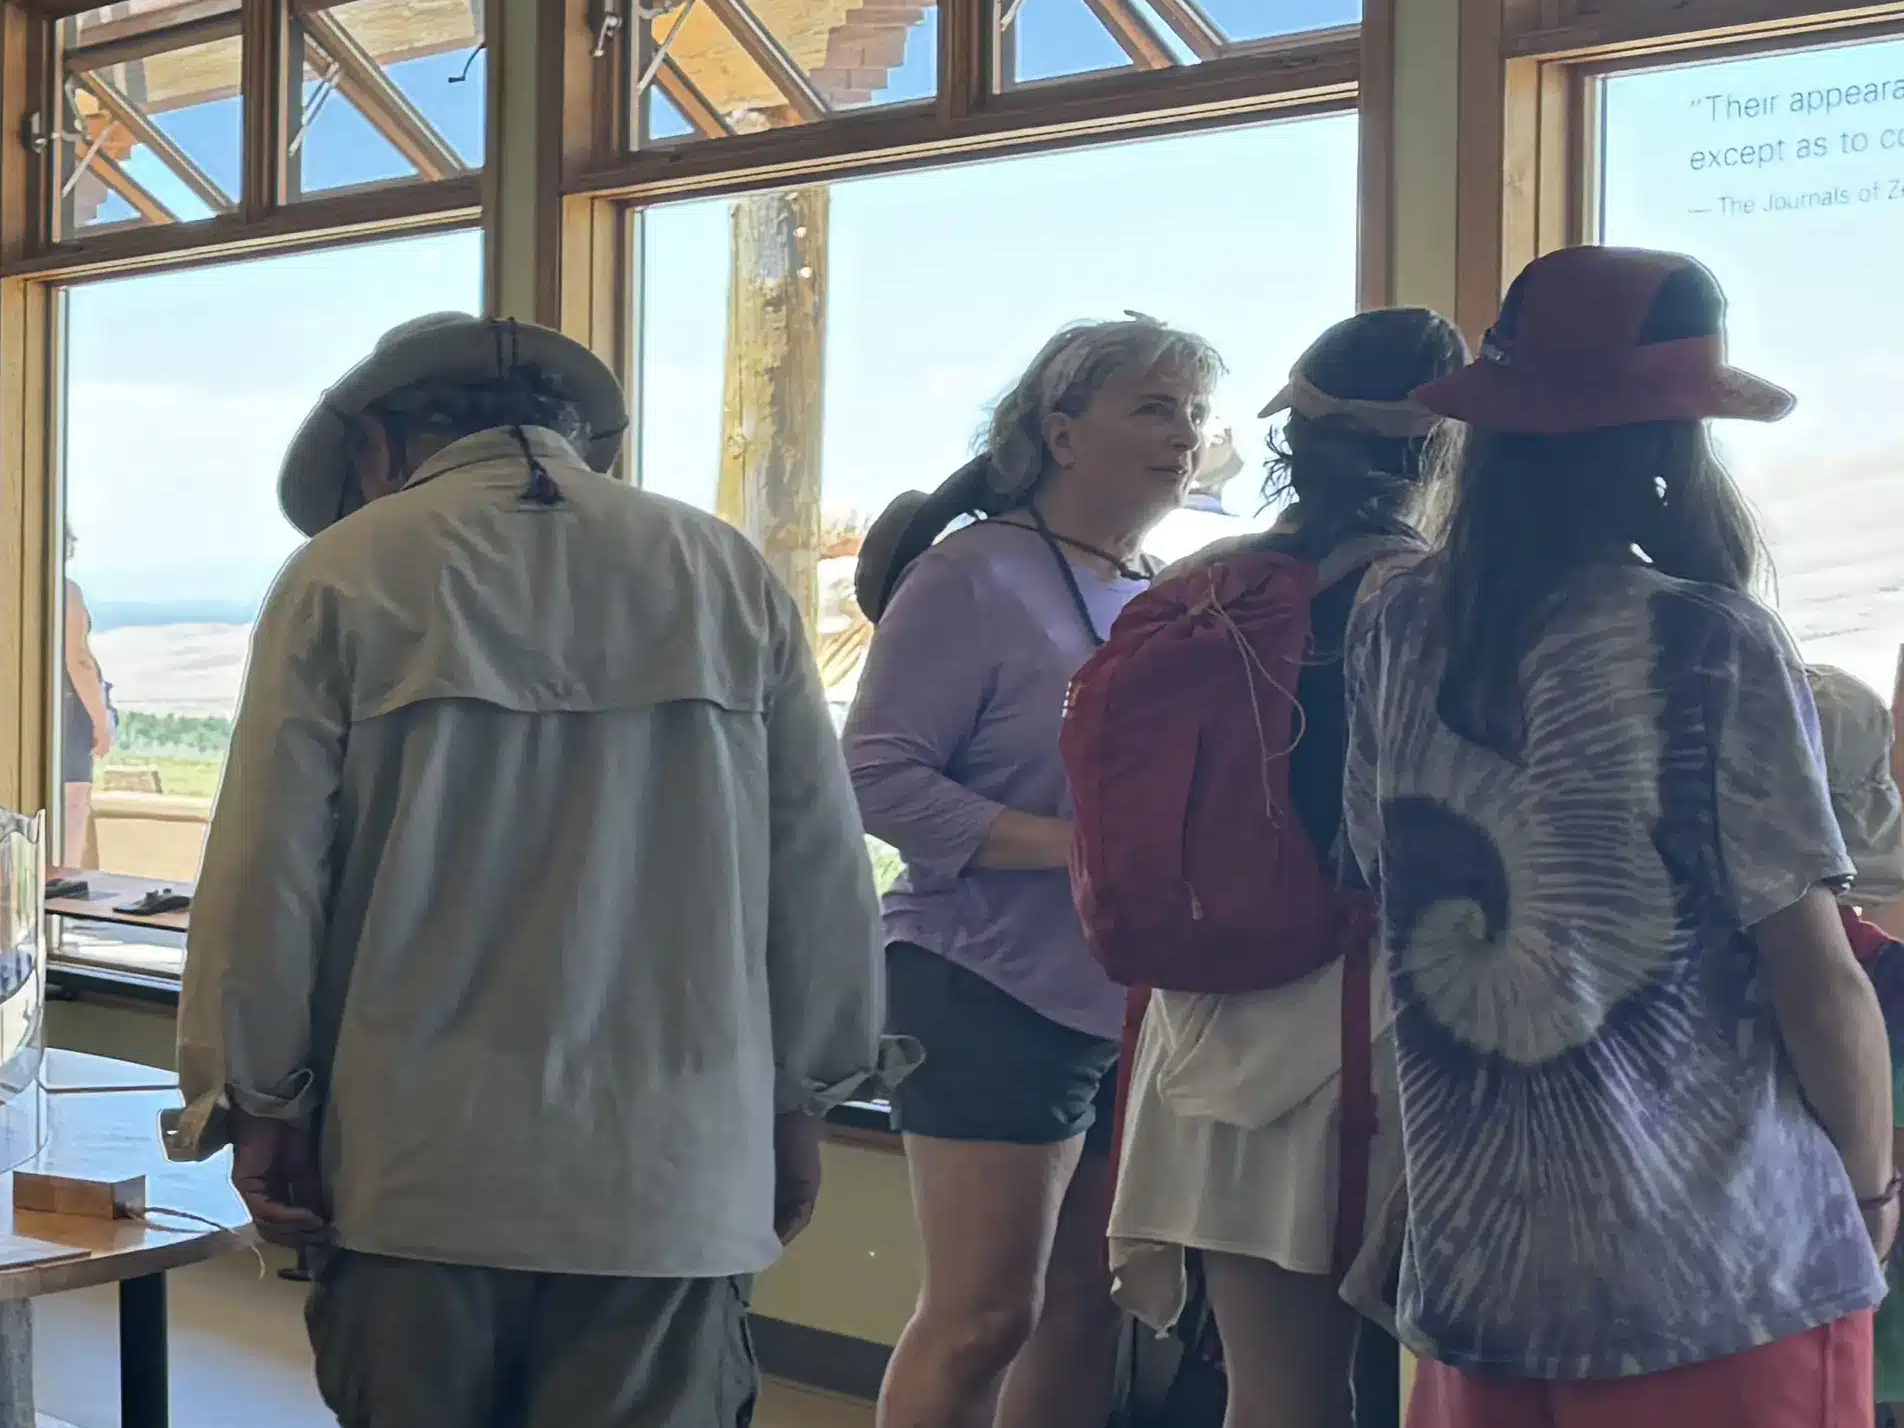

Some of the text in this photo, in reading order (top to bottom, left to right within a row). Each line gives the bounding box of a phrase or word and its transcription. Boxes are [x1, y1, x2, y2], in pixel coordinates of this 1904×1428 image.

[1789, 78, 1904, 116] appeara
[1690, 138, 1785, 170] except
[1796, 136, 1828, 159] as
[1839, 131, 1869, 154] to
[1717, 195, 1755, 216] The
[1762, 185, 1850, 213] Journals
[1858, 179, 1881, 203] of
[1887, 178, 1904, 201] Z
